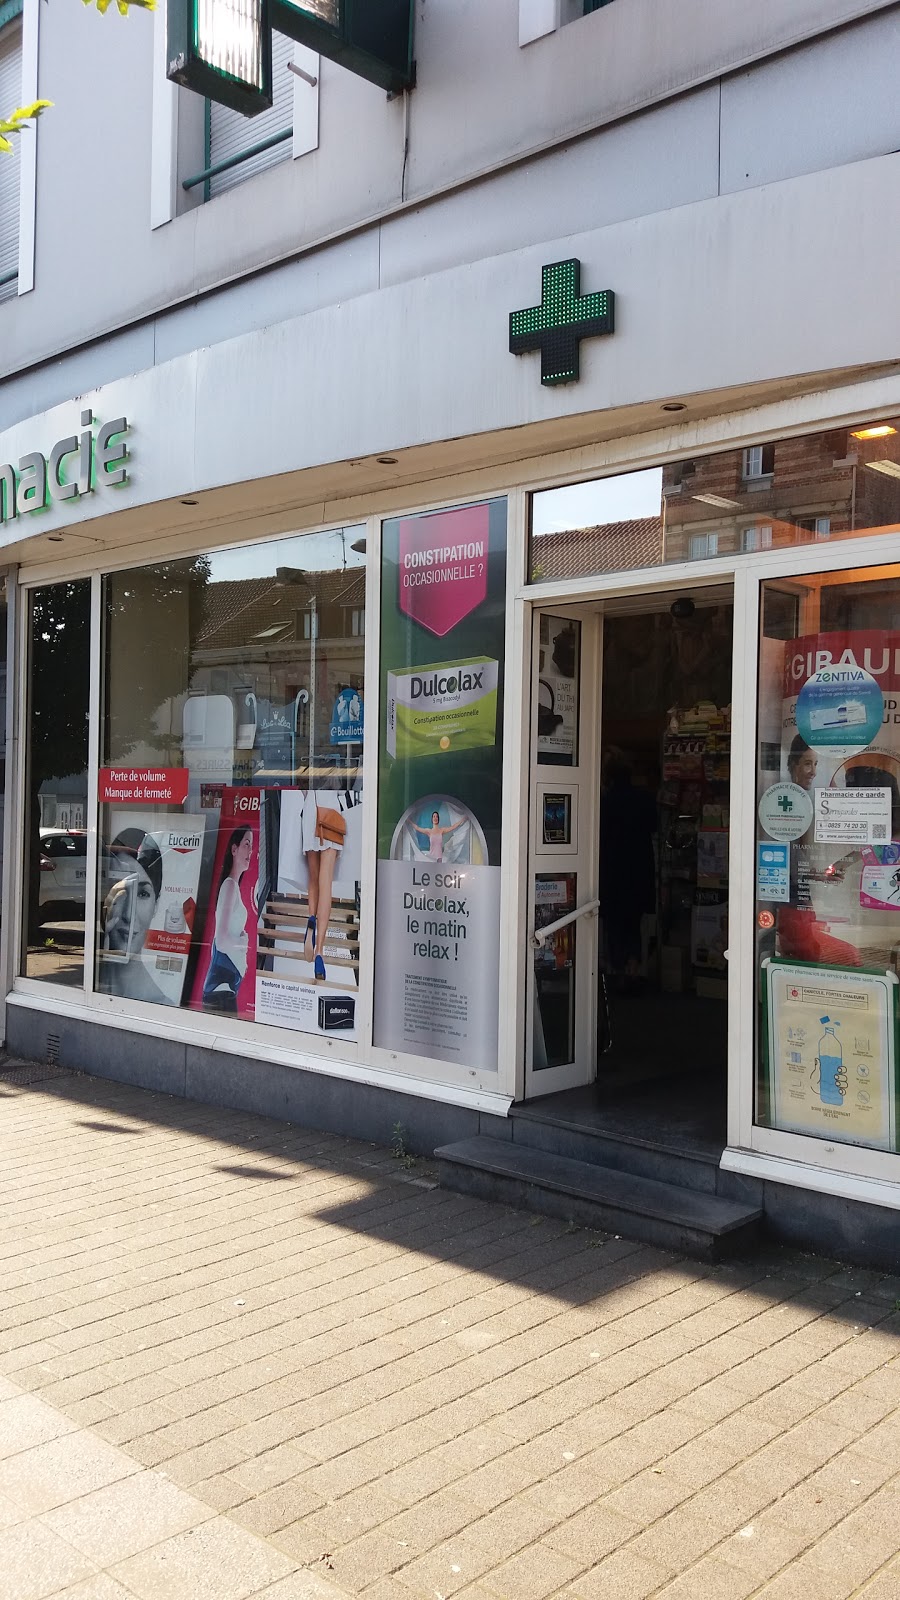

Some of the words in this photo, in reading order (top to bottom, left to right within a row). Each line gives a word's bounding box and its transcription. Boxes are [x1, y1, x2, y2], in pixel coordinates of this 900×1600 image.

[404, 541, 484, 569] CONSTIPATION
[403, 564, 475, 588] OCCASIONNELLE
[478, 563, 484, 576] ?
[410, 670, 484, 699] Dulcolax
[413, 712, 446, 724] Constipation
[446, 709, 479, 721] occasionnelle
[110, 771, 128, 782] Perte
[129, 770, 138, 781] de
[139, 770, 166, 782] volume
[104, 787, 133, 800] Manque
[134, 787, 142, 798] de
[144, 786, 172, 799] fermeté
[865, 791, 885, 799] garde
[239, 797, 260, 811] GIB
[168, 834, 199, 847] Eucerin
[412, 868, 430, 886] Le
[434, 871, 462, 889] soir
[403, 892, 469, 918] Dulcolax,
[407, 915, 419, 933] le
[424, 920, 467, 939] matin
[413, 940, 449, 960] relax
[454, 943, 458, 960] !
[794, 968, 820, 977] pharmacien
[261, 980, 281, 989] Renforce
